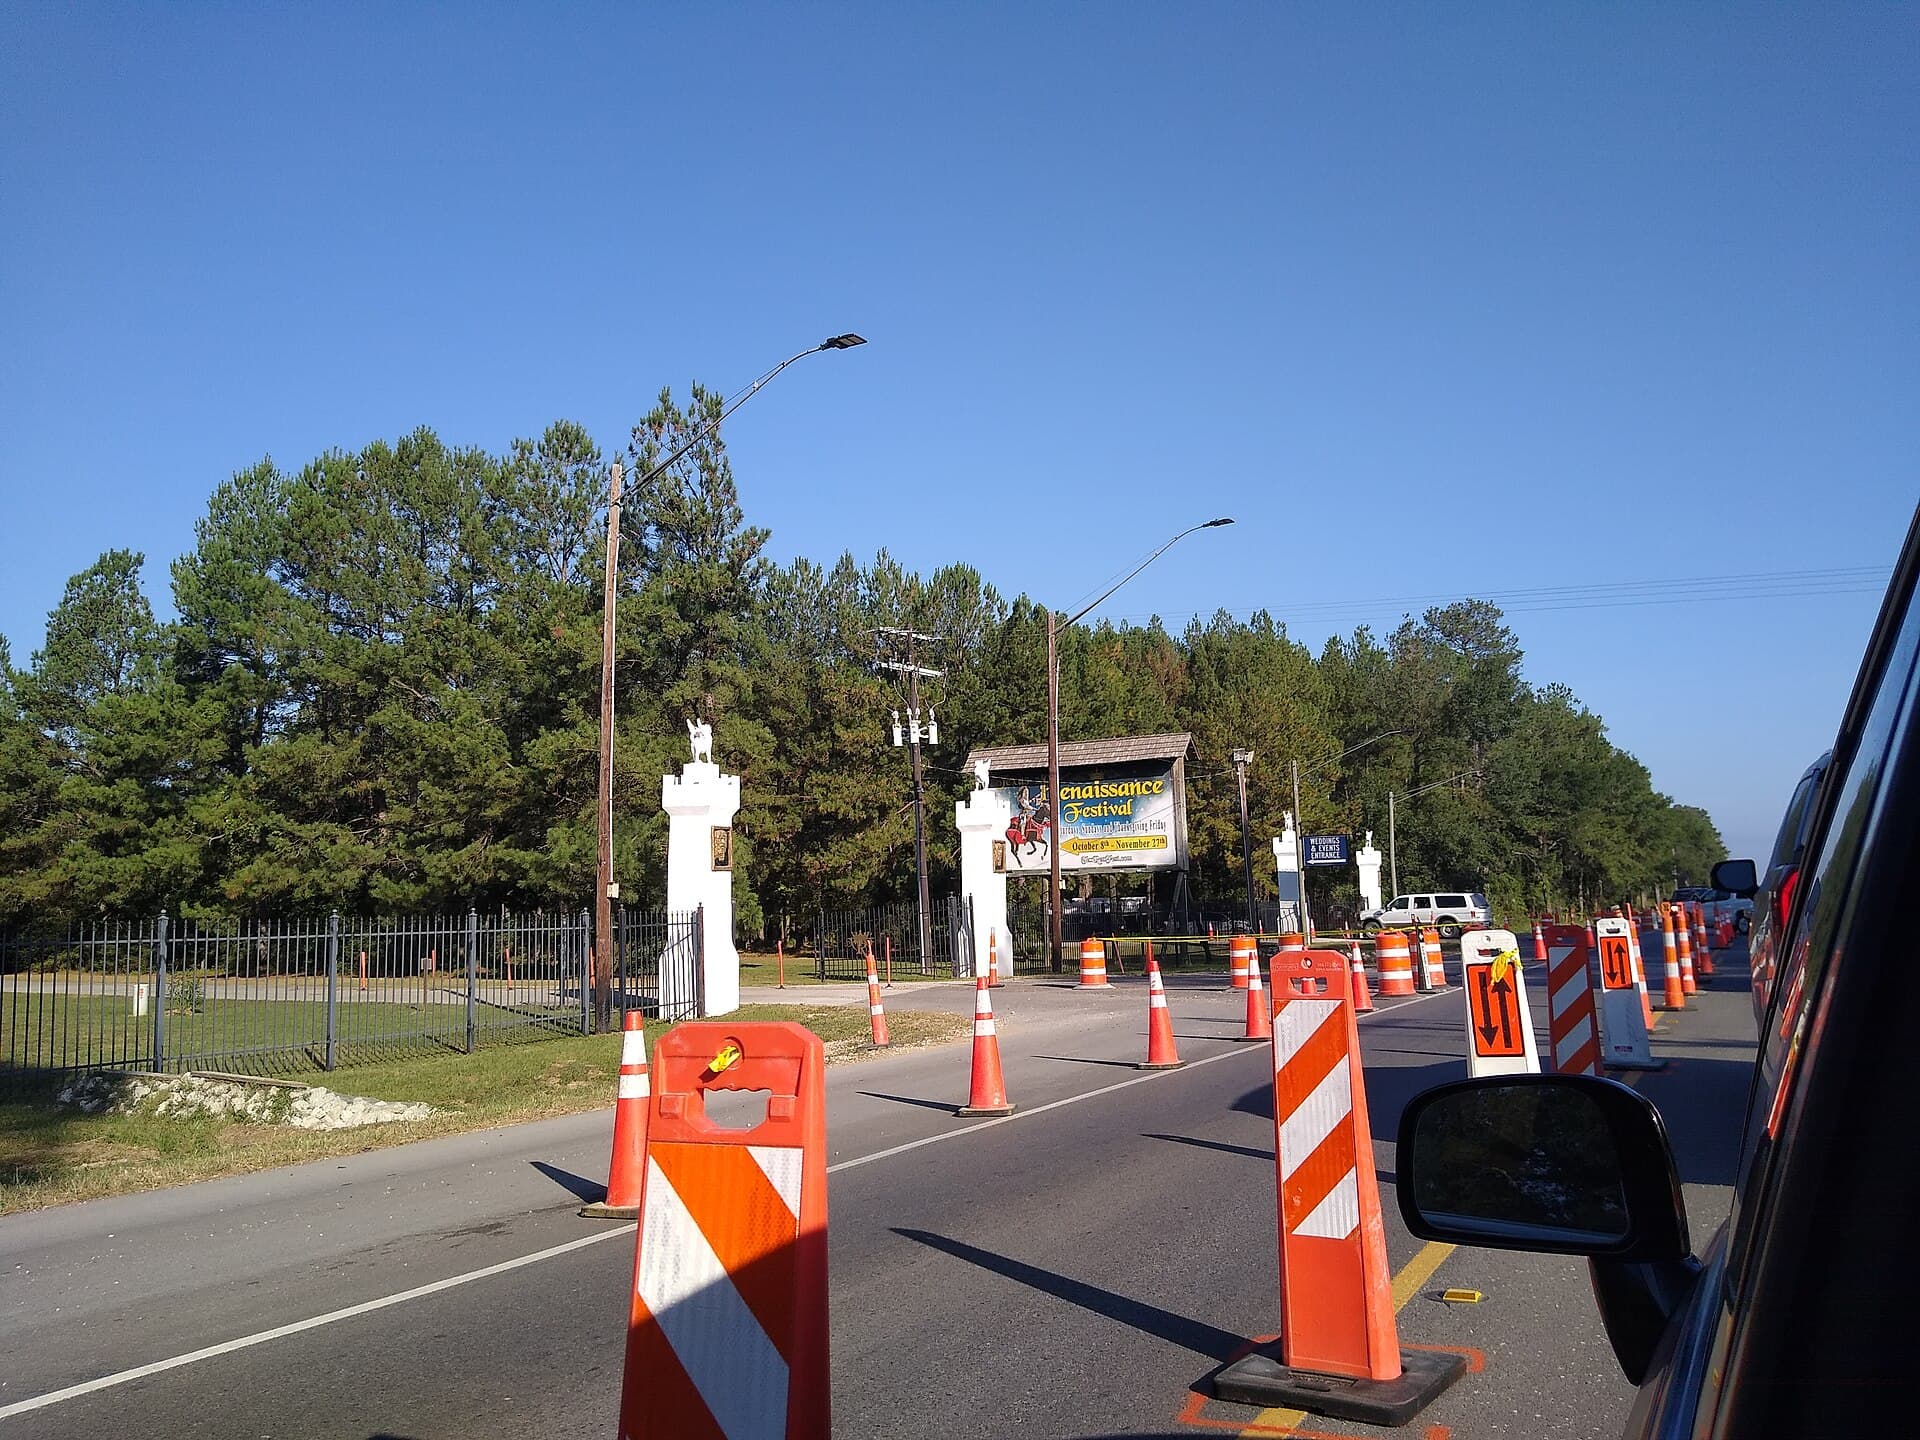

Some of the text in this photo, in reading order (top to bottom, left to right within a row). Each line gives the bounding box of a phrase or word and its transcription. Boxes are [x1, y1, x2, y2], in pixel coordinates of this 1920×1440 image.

[1063, 799, 1133, 823] Festival
[1113, 819, 1148, 833] Thanksgiving
[1149, 819, 1166, 832] Friday
[1072, 841, 1099, 851] October
[1100, 840, 1109, 849] 8th
[1115, 839, 1150, 849] November
[1152, 838, 1165, 848] 27th
[1310, 837, 1340, 845] WEDDINGS
